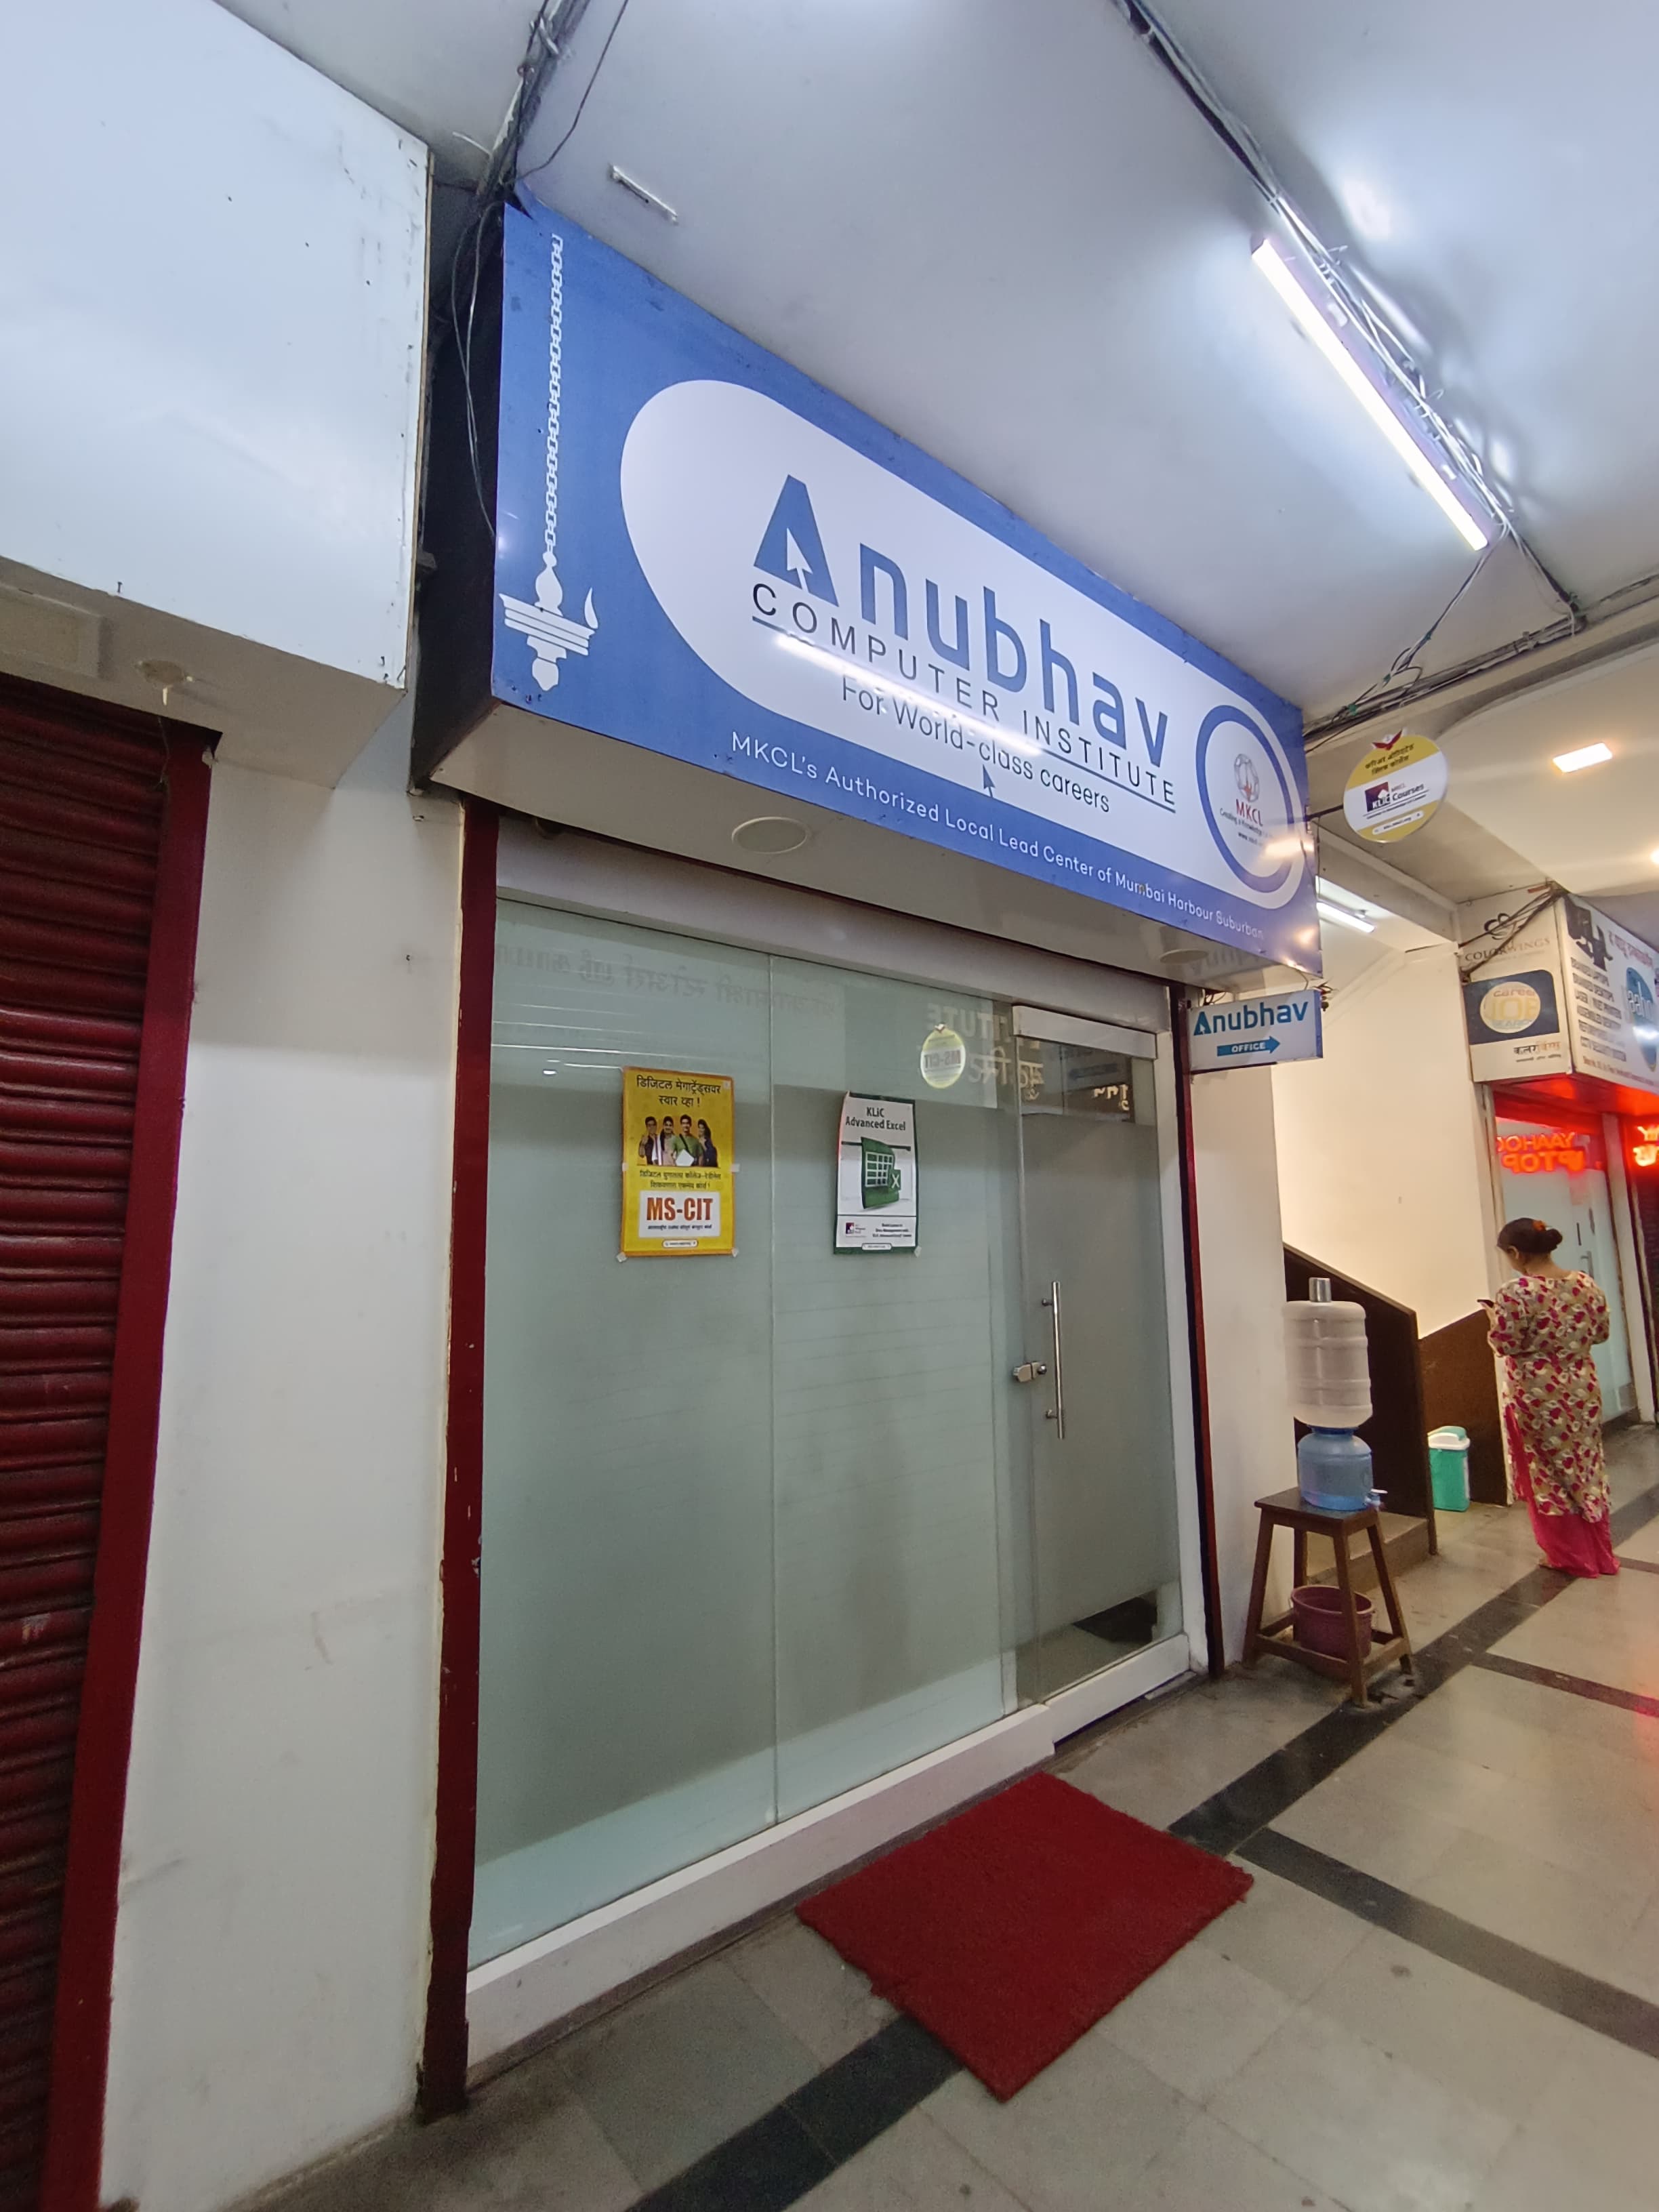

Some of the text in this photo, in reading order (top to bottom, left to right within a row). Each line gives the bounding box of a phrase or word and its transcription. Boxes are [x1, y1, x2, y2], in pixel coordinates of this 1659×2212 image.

[753, 474, 1168, 767] Anubhav
[752, 583, 1175, 806] COMPUTER INSTITUTE
[842, 674, 1109, 813] For World-class careers
[1392, 783, 1425, 802] Courses
[1235, 798, 1263, 827] MKCL
[732, 731, 1265, 941] MKCL's Authorized Local Lead Center of Mumbai Harbour Suburban
[1193, 1001, 1309, 1036] Anubhav
[1231, 1042, 1266, 1053] OFFICE
[636, 1074, 673, 1090] डिजिटल
[658, 1094, 678, 1106] स्वार
[681, 1096, 694, 1108] व्हा
[866, 1106, 884, 1118] KLiC
[845, 1115, 906, 1131] Advanced Excel
[647, 1197, 714, 1221] MS-CIT
